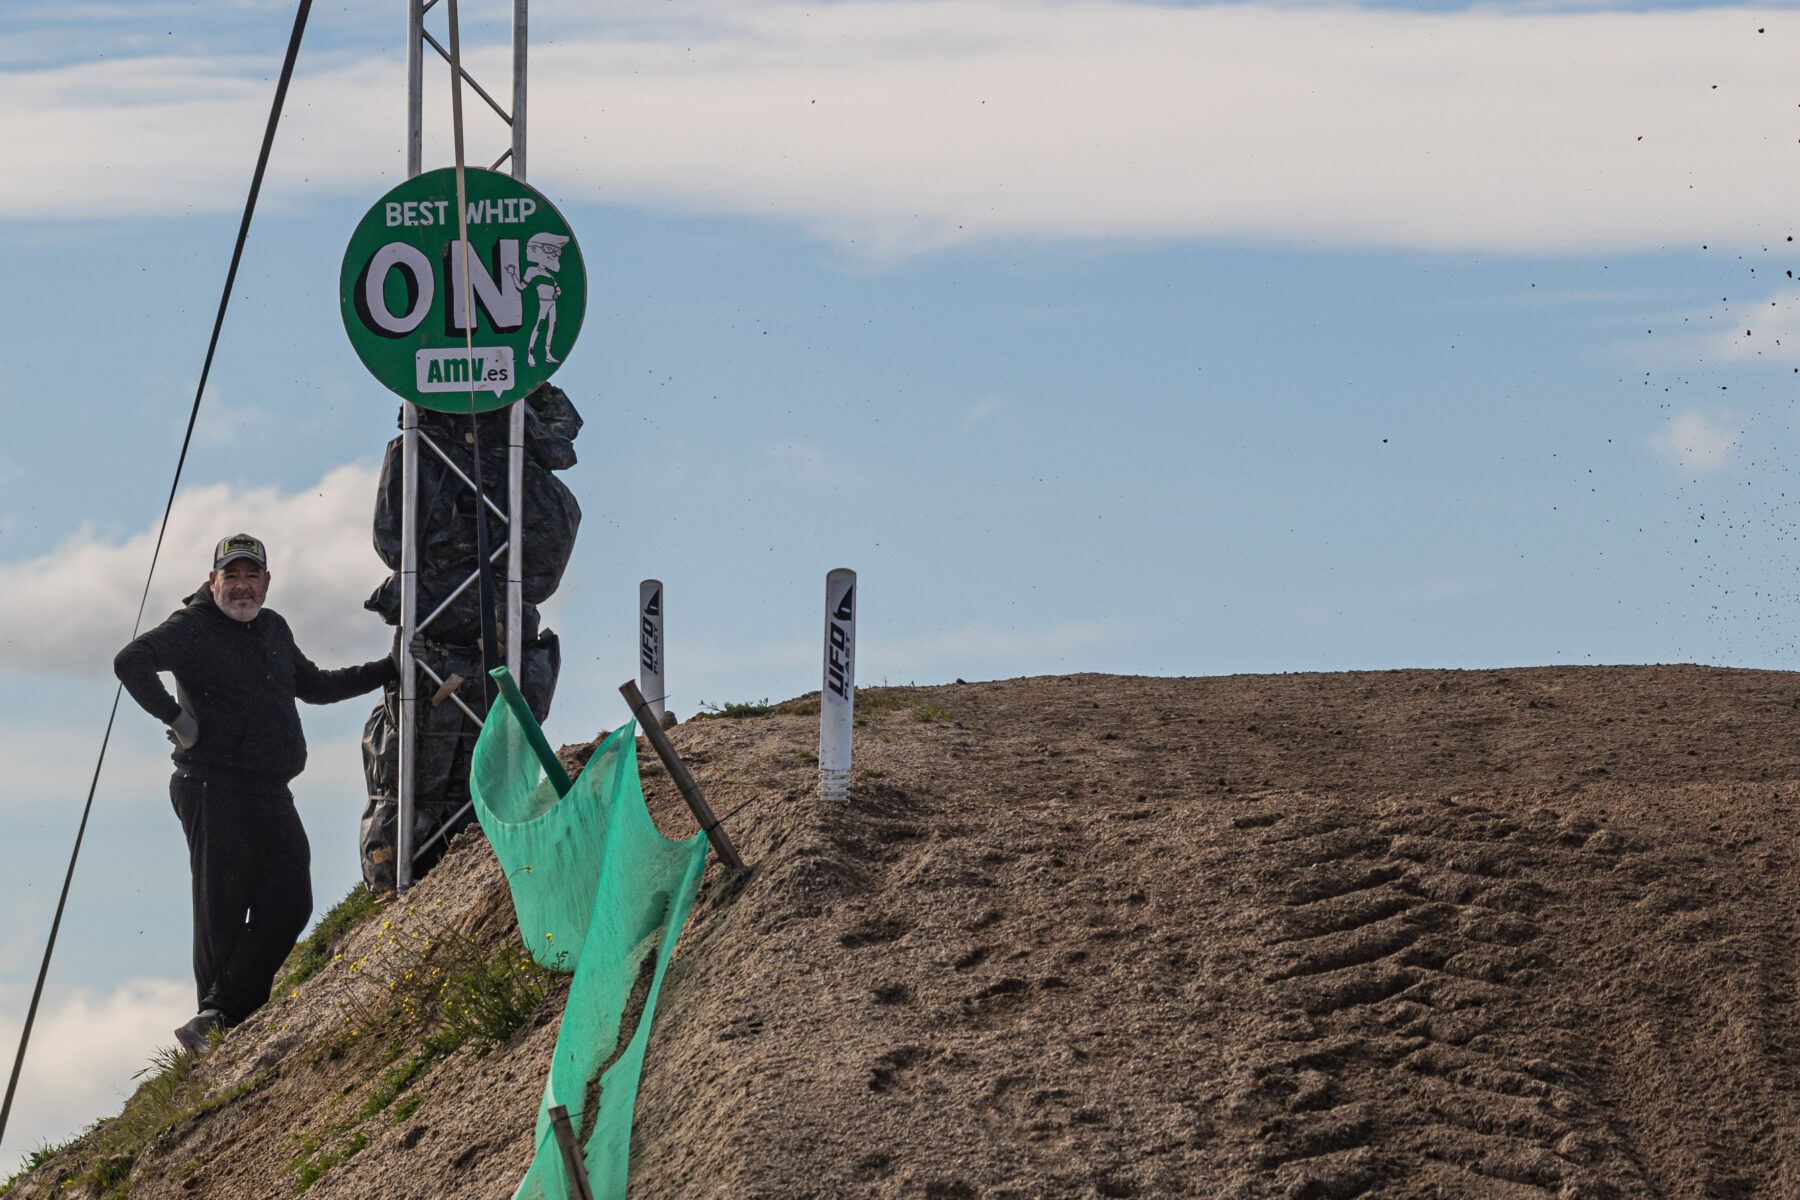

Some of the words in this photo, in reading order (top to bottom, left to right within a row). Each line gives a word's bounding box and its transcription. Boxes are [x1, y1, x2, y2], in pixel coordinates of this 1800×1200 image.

[385, 200, 448, 227] BEST
[465, 197, 537, 225] WHIP
[353, 238, 524, 339] ON
[642, 616, 654, 672] UFO
[828, 622, 845, 697] UFO
[843, 630, 852, 701] PLAST
